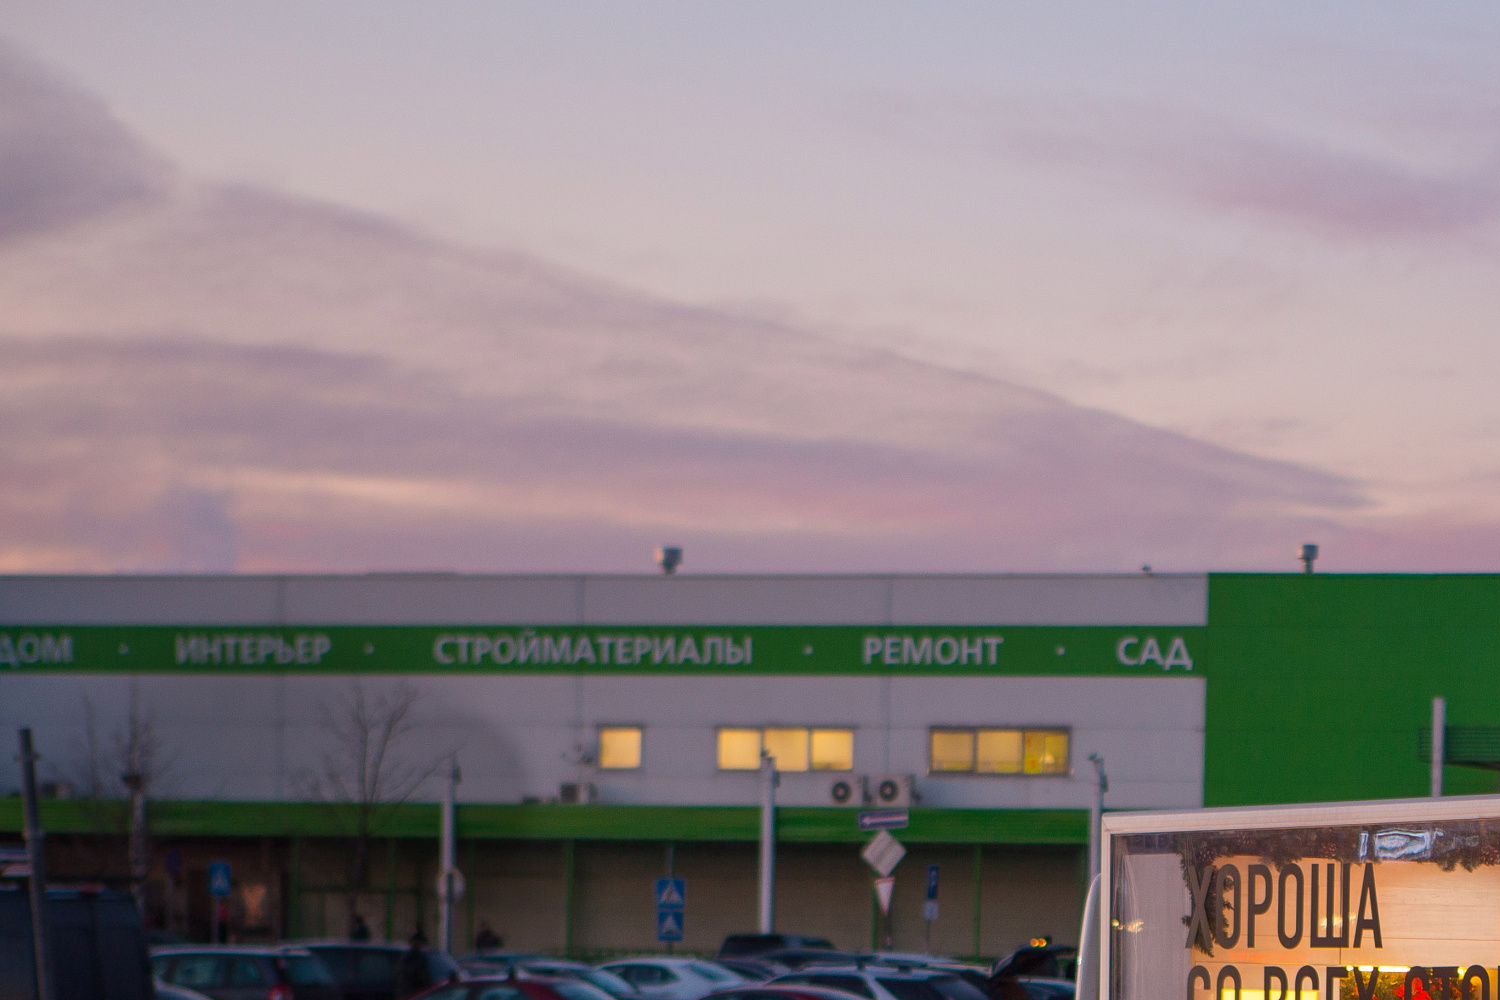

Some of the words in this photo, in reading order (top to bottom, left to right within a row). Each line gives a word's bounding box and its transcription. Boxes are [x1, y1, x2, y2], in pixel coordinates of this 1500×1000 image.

[175, 634, 331, 664] ИНТЕРЬЕР
[433, 630, 753, 665] СТРОЙМАТЕРИАЛЫ
[864, 635, 1003, 665] РЕМОНТ
[1117, 636, 1193, 671] САД
[1185, 862, 1383, 949] ХОРОША
